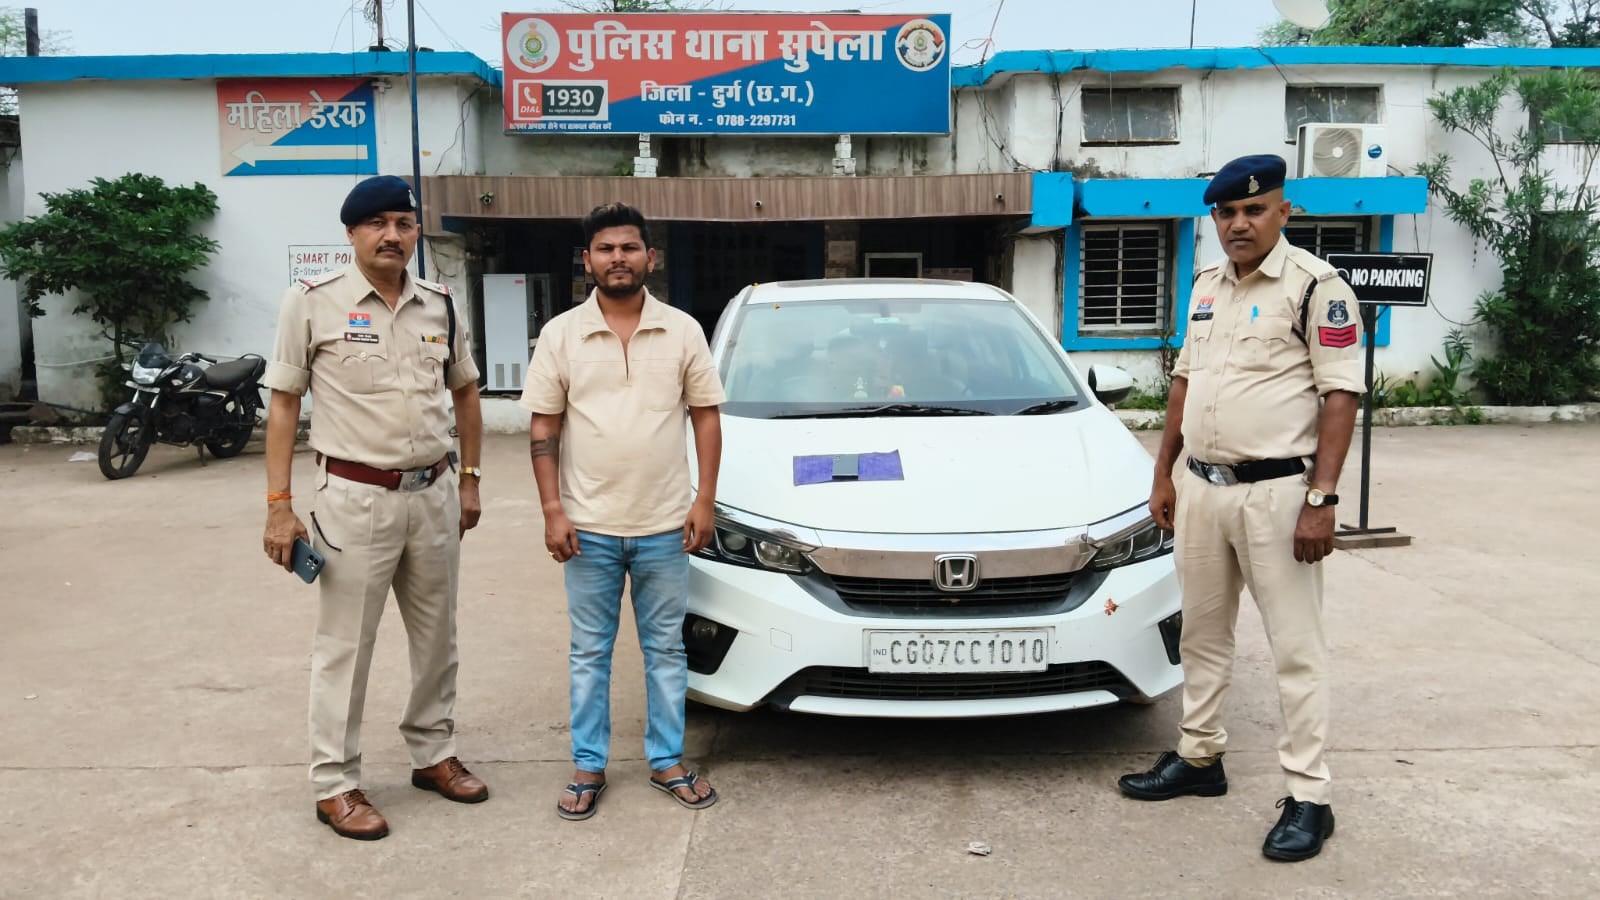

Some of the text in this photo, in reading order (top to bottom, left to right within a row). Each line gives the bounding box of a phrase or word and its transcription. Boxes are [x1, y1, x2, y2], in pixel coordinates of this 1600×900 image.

[566, 20, 887, 73] पुलिस थाना सुपेला
[546, 88, 595, 107] 1930
[640, 80, 693, 102] जिला
[712, 80, 742, 108] दुर्ग
[747, 80, 814, 107] (छ.ग.)
[225, 90, 367, 133] महिला डेस्क
[520, 105, 541, 113] DIAL
[659, 111, 685, 126] फोन
[716, 114, 796, 127] 0788-2297731
[296, 252, 329, 265] SMART
[1350, 268, 1370, 286] NO
[1370, 269, 1424, 288] PARKING
[890, 638, 1044, 665] CG07CC1010
